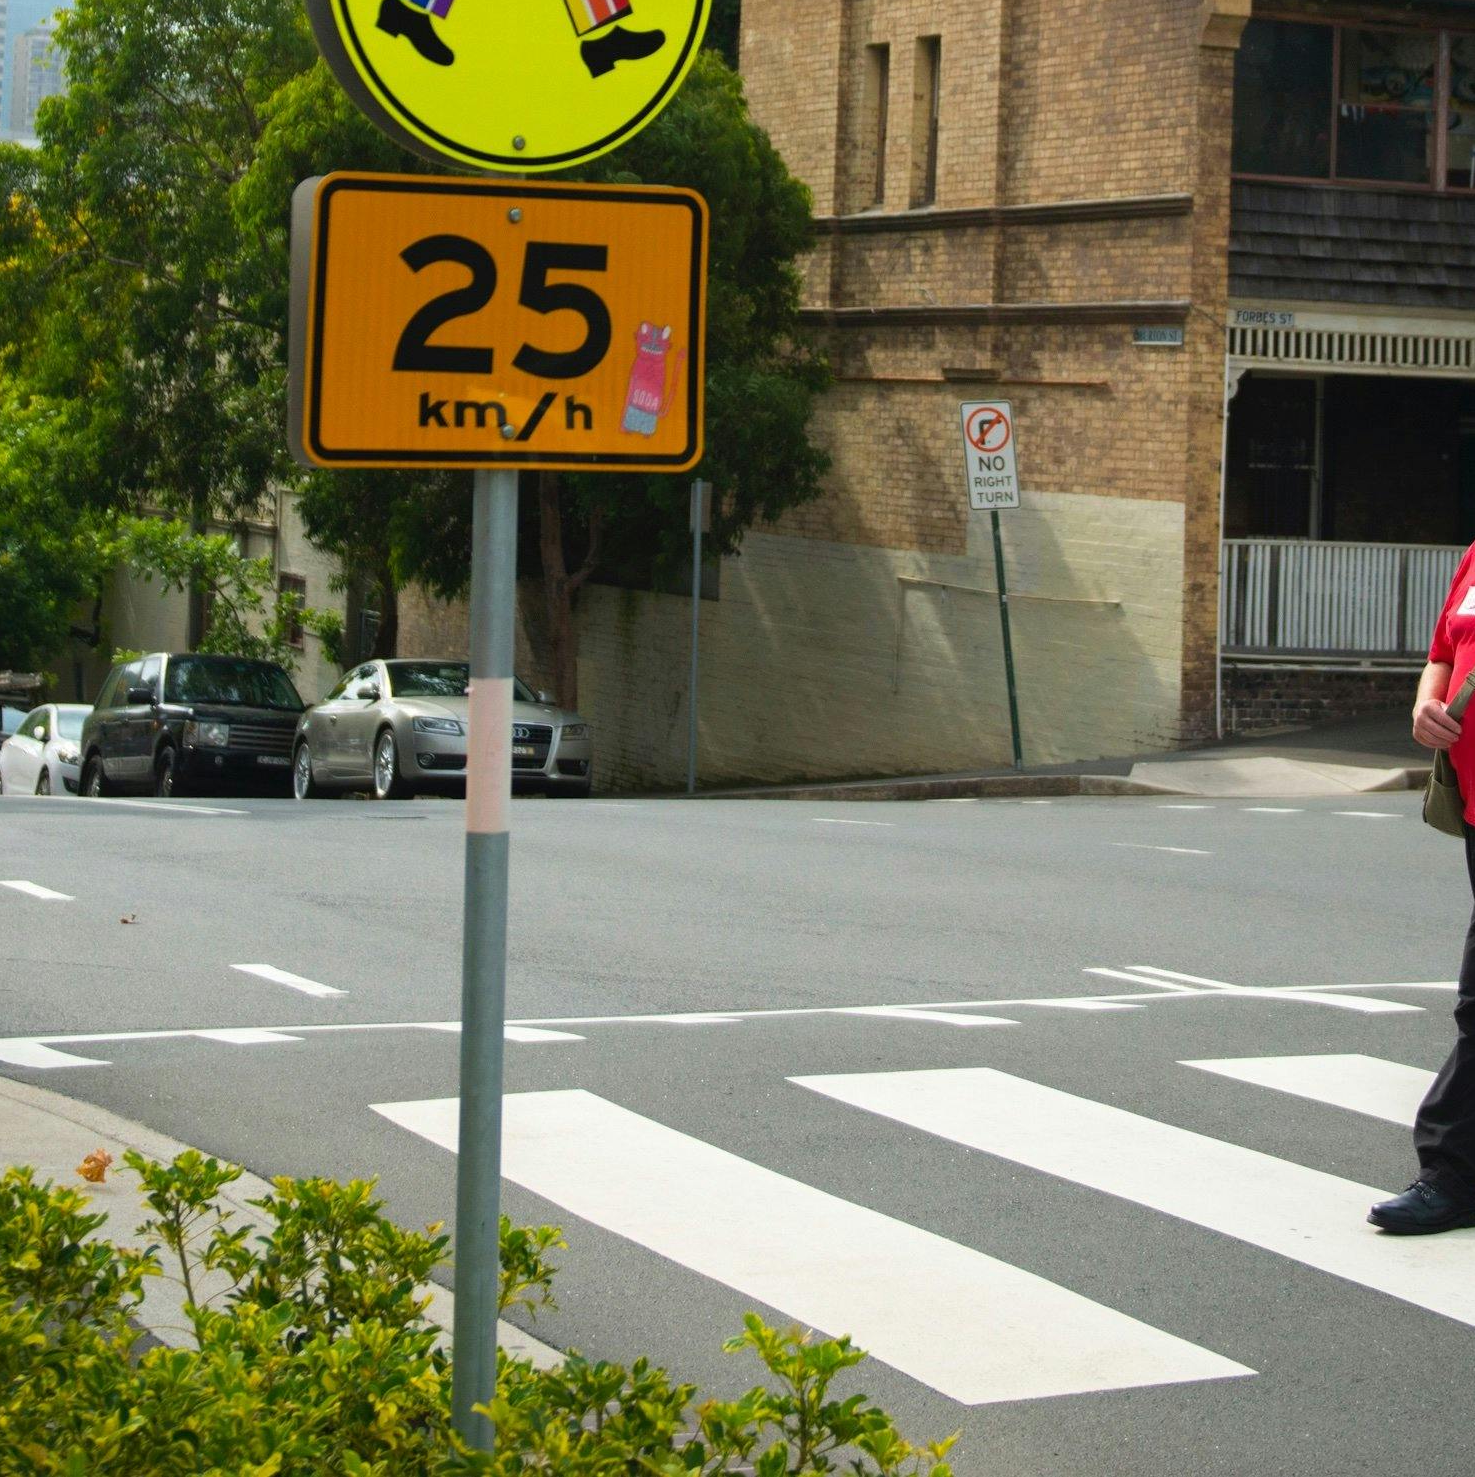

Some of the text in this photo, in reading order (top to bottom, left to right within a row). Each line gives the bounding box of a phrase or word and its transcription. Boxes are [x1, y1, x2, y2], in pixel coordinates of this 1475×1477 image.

[392, 234, 612, 379] 25
[1236, 310, 1293, 325] FORBES ST
[420, 391, 593, 442] km/h
[978, 455, 1005, 472] NO
[974, 476, 1012, 488] RIGHT
[976, 491, 1014, 503] TURN
